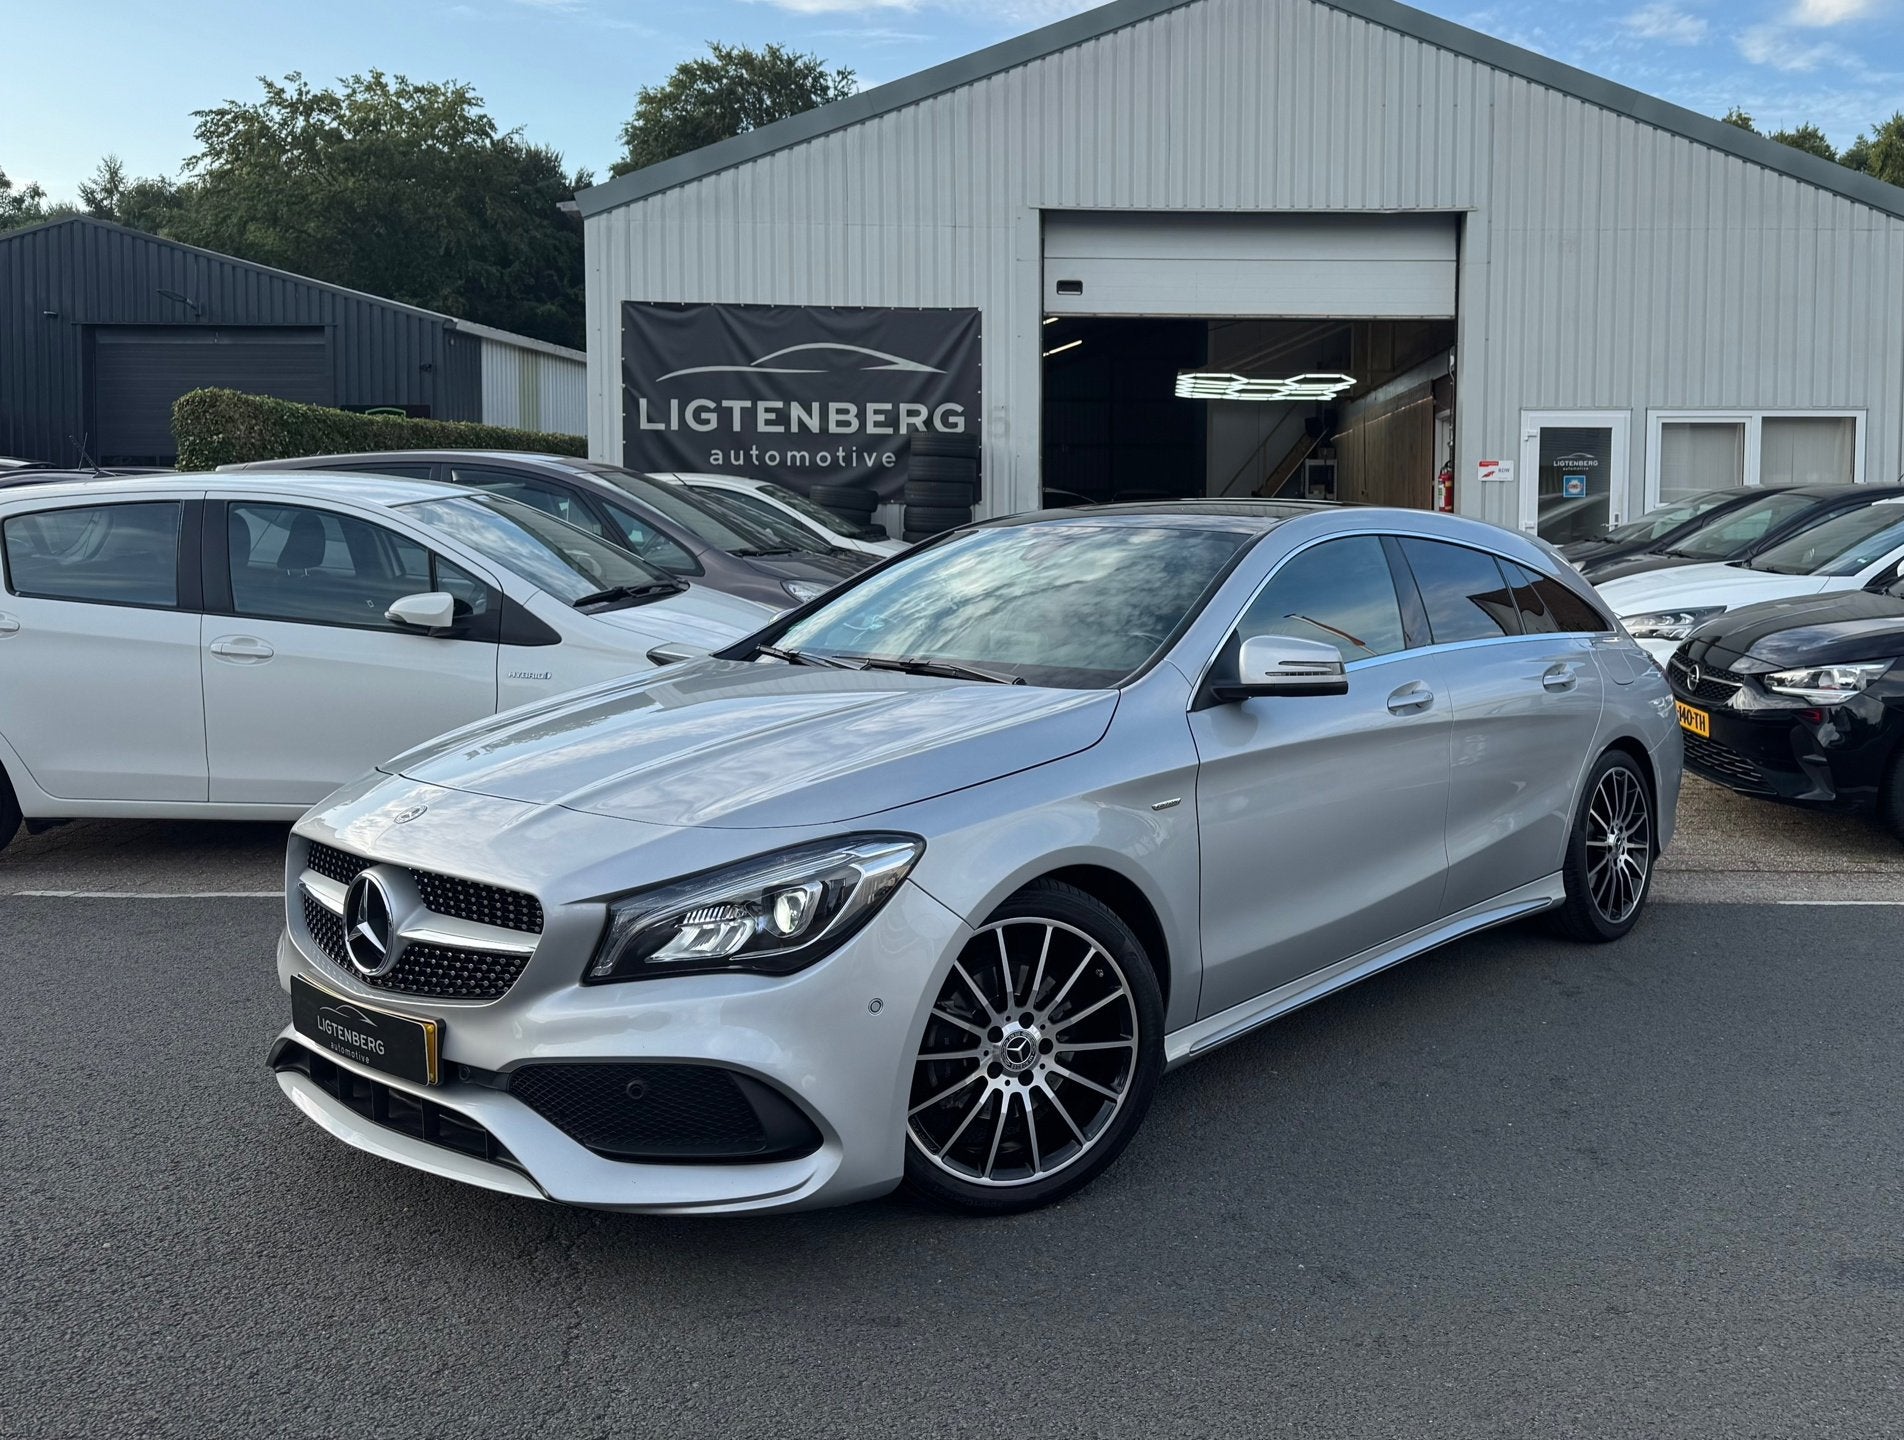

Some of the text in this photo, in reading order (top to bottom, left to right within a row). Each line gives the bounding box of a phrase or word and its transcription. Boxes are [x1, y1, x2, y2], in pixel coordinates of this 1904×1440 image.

[639, 398, 966, 435] LIGTENBERG
[709, 446, 897, 468] automotive
[508, 672, 545, 680] HYBRID
[316, 1015, 385, 1055] LIGTENBERG
[330, 1041, 370, 1064] automotive
